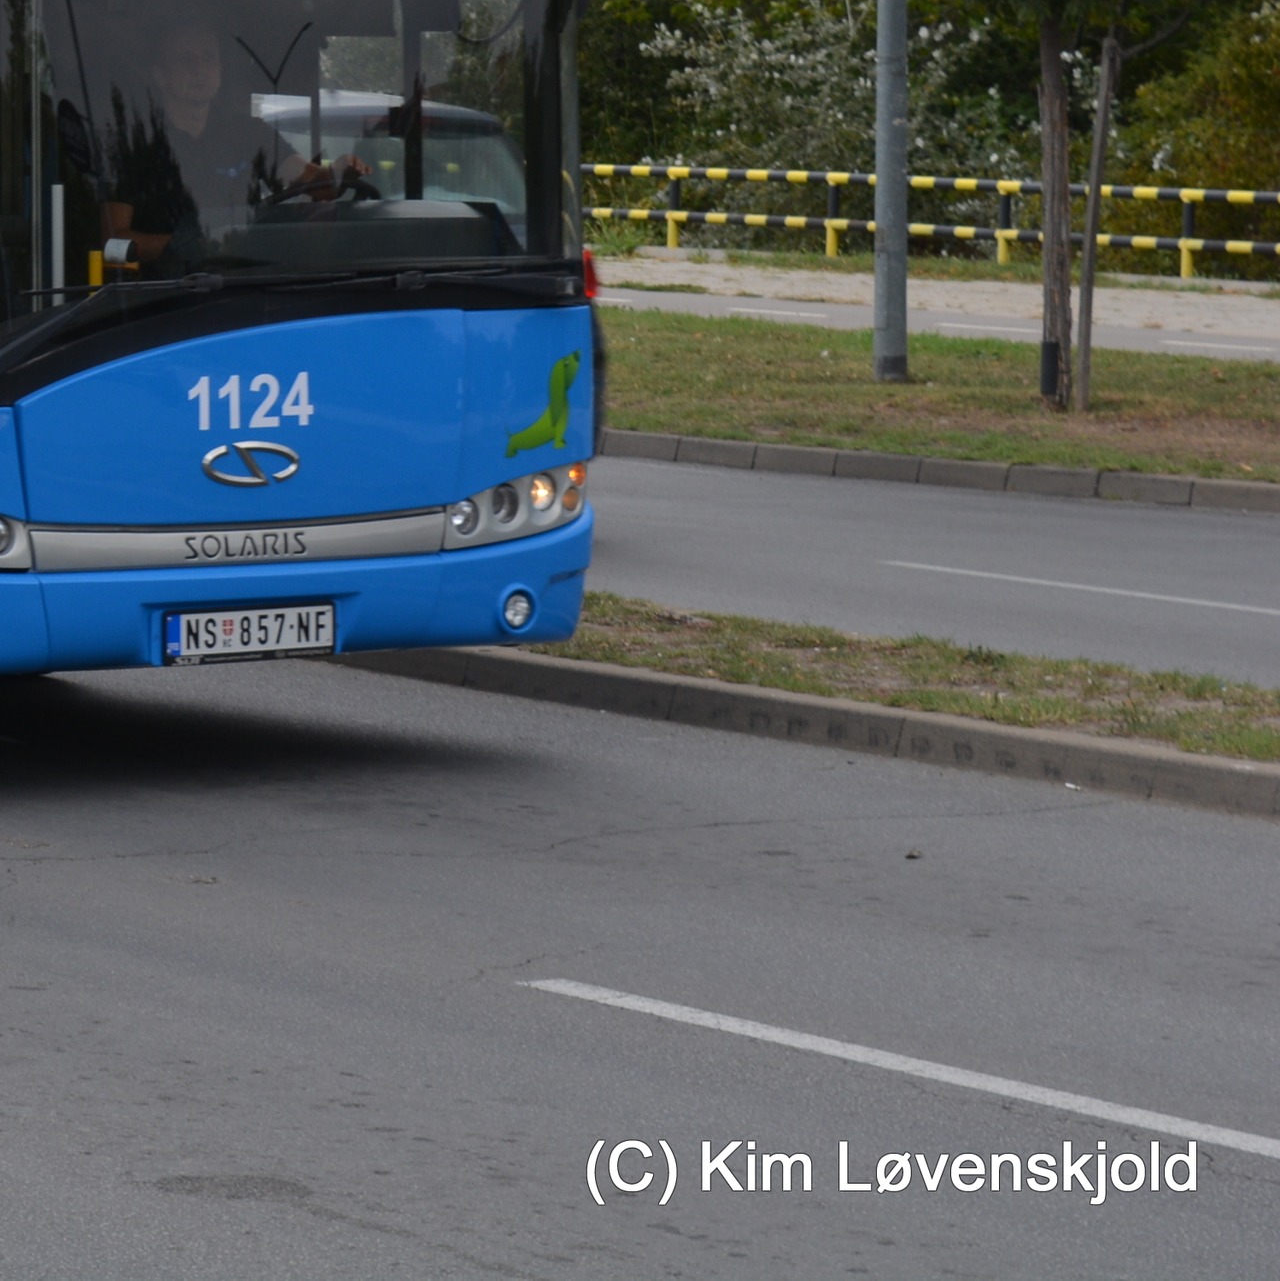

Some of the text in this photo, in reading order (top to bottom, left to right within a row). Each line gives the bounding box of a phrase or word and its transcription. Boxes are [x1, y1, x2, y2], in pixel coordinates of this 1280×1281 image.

[188, 371, 315, 431] 1124
[184, 531, 307, 560] SOLARIS
[186, 617, 217, 650] NS
